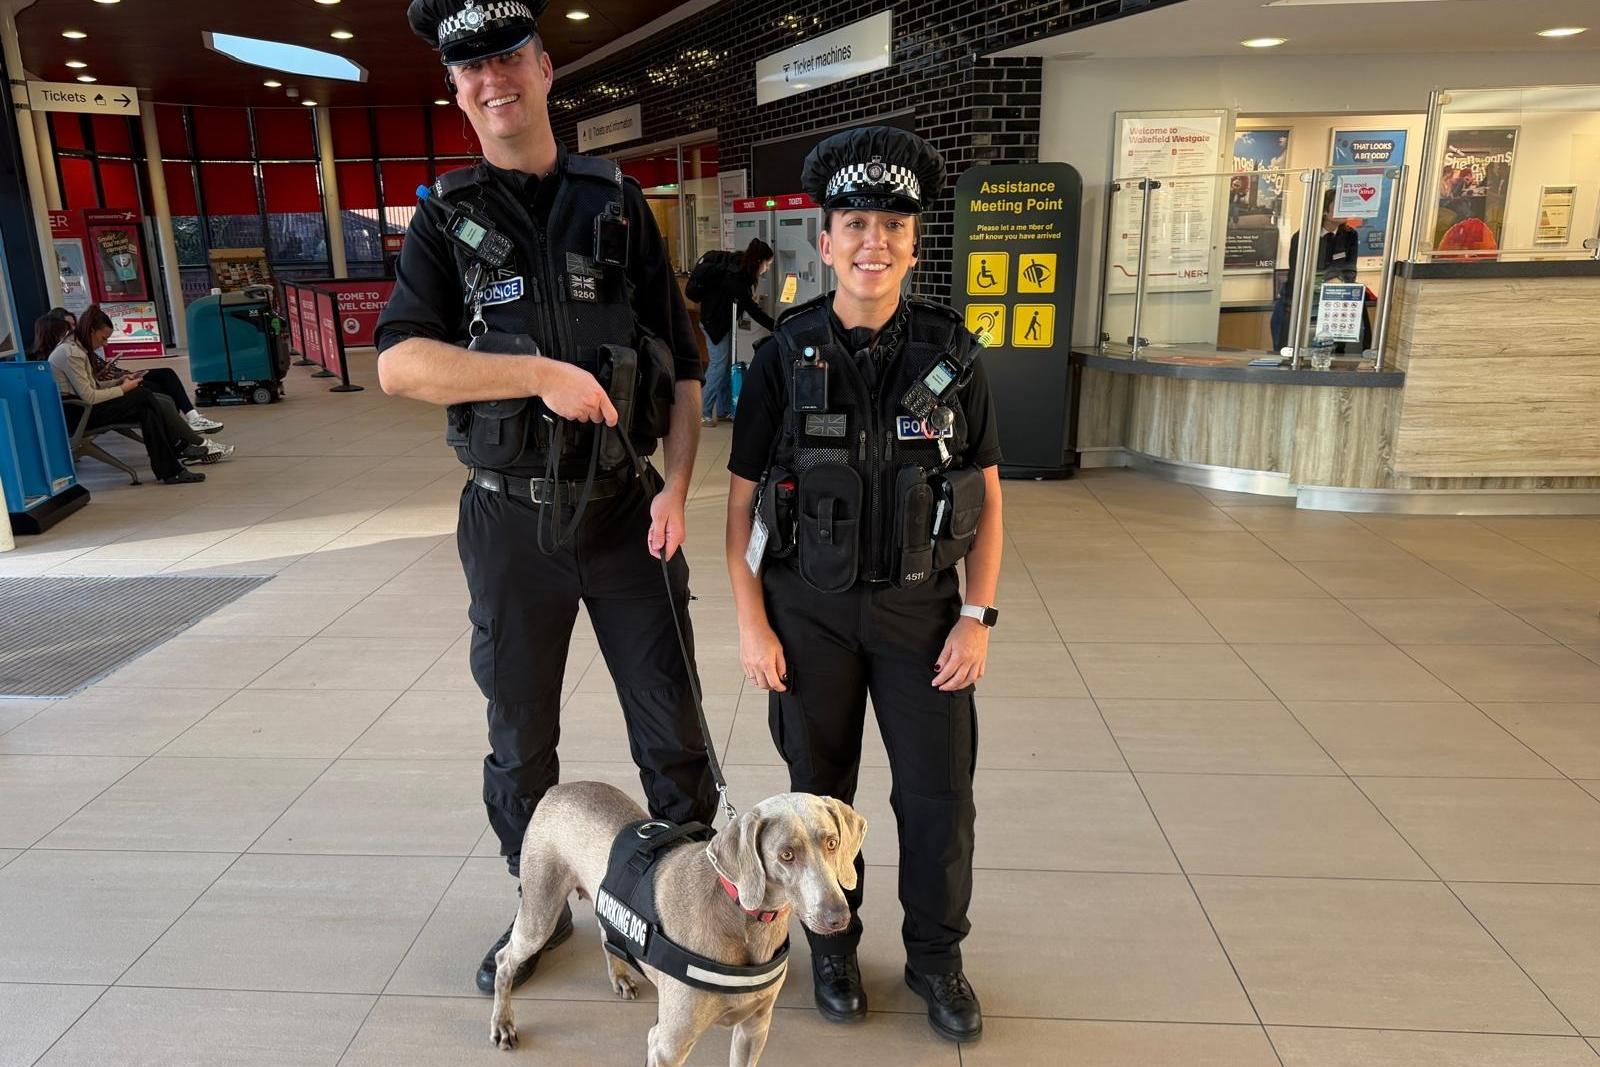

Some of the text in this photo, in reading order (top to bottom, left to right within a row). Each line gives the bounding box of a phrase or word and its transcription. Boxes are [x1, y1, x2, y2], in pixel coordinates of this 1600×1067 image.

[793, 44, 852, 76] Ticket machines
[41, 90, 87, 103] Tickets
[1129, 135, 1210, 144] Wakefield Westgate
[980, 181, 1055, 194] Assistance
[970, 198, 1063, 214] Meeting Point
[49, 215, 69, 227] ER
[977, 224, 999, 232] Please
[969, 233, 985, 241] staff
[1178, 269, 1204, 279] LNER
[337, 292, 380, 301] COME TO
[573, 290, 595, 299] 3250
[905, 571, 924, 581] 4511
[597, 889, 647, 947] WORKING DOG
